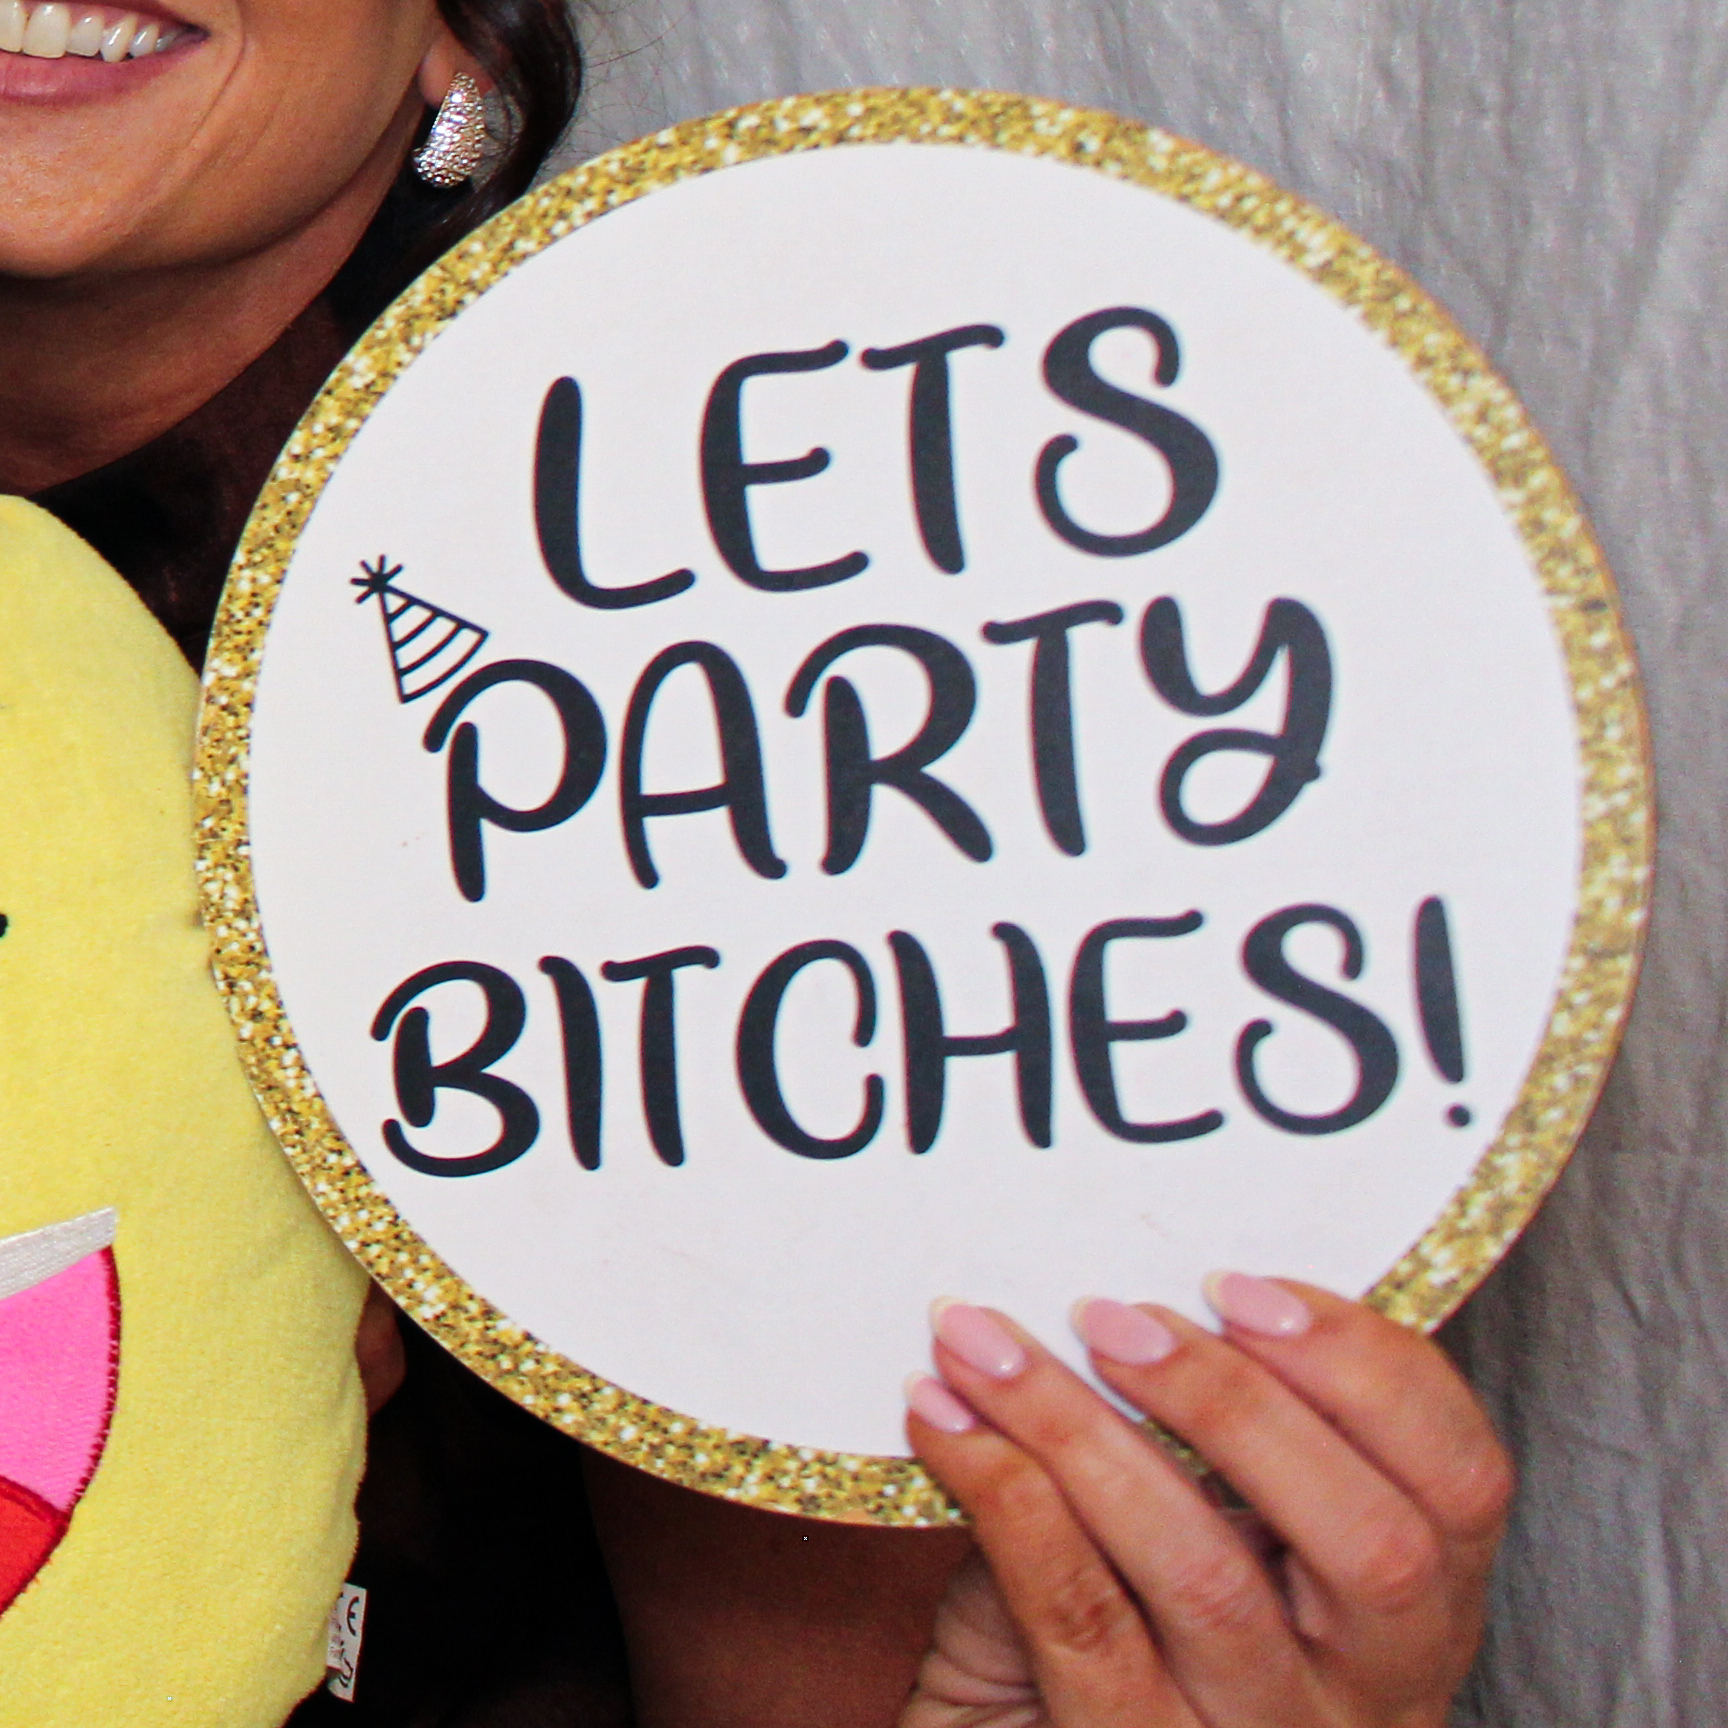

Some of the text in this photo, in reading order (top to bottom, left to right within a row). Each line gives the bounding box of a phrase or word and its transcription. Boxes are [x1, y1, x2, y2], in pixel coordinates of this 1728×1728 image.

[531, 305, 1221, 611] LETS
[421, 595, 1334, 904] PARTY
[369, 895, 1474, 1180] BITCHES!
